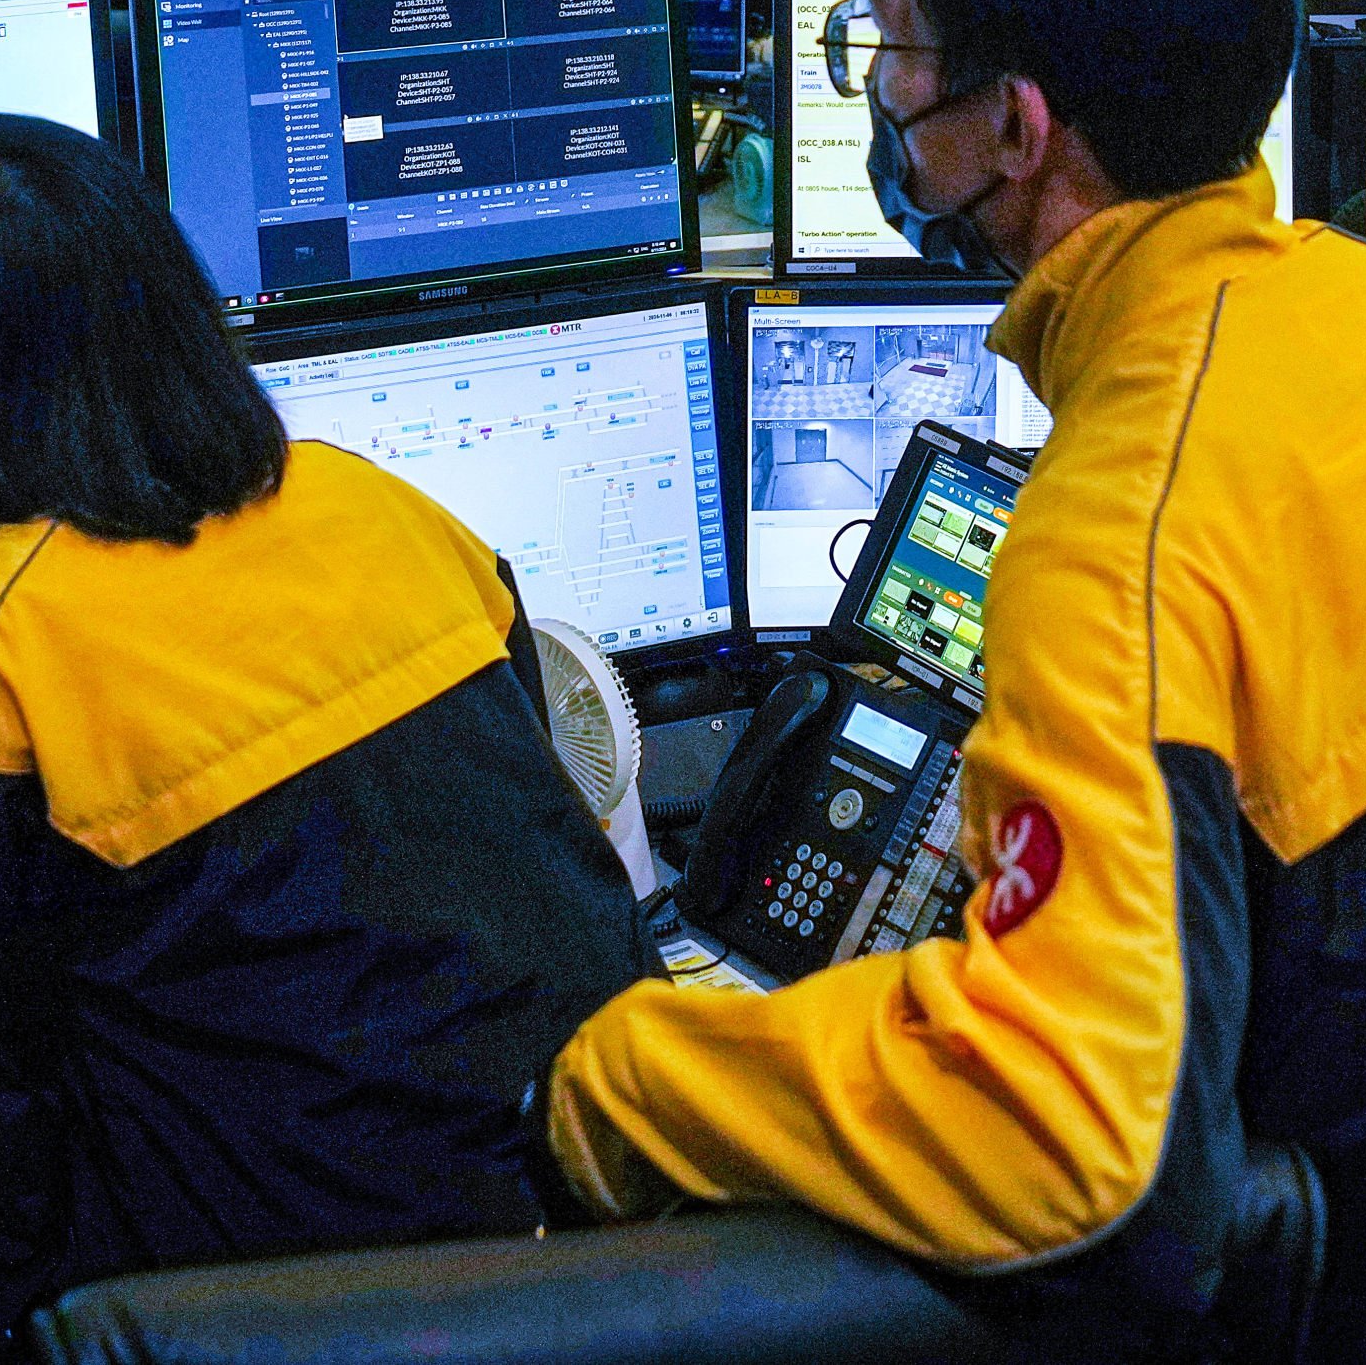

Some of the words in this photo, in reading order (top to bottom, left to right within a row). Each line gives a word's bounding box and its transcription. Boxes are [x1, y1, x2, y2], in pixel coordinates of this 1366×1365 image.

[175, 2, 202, 10] Monitoring
[845, 139, 860, 148] ISL)
[419, 286, 469, 301] SAMSUNG
[757, 291, 798, 300] LLA-B
[561, 321, 582, 333] MTR
